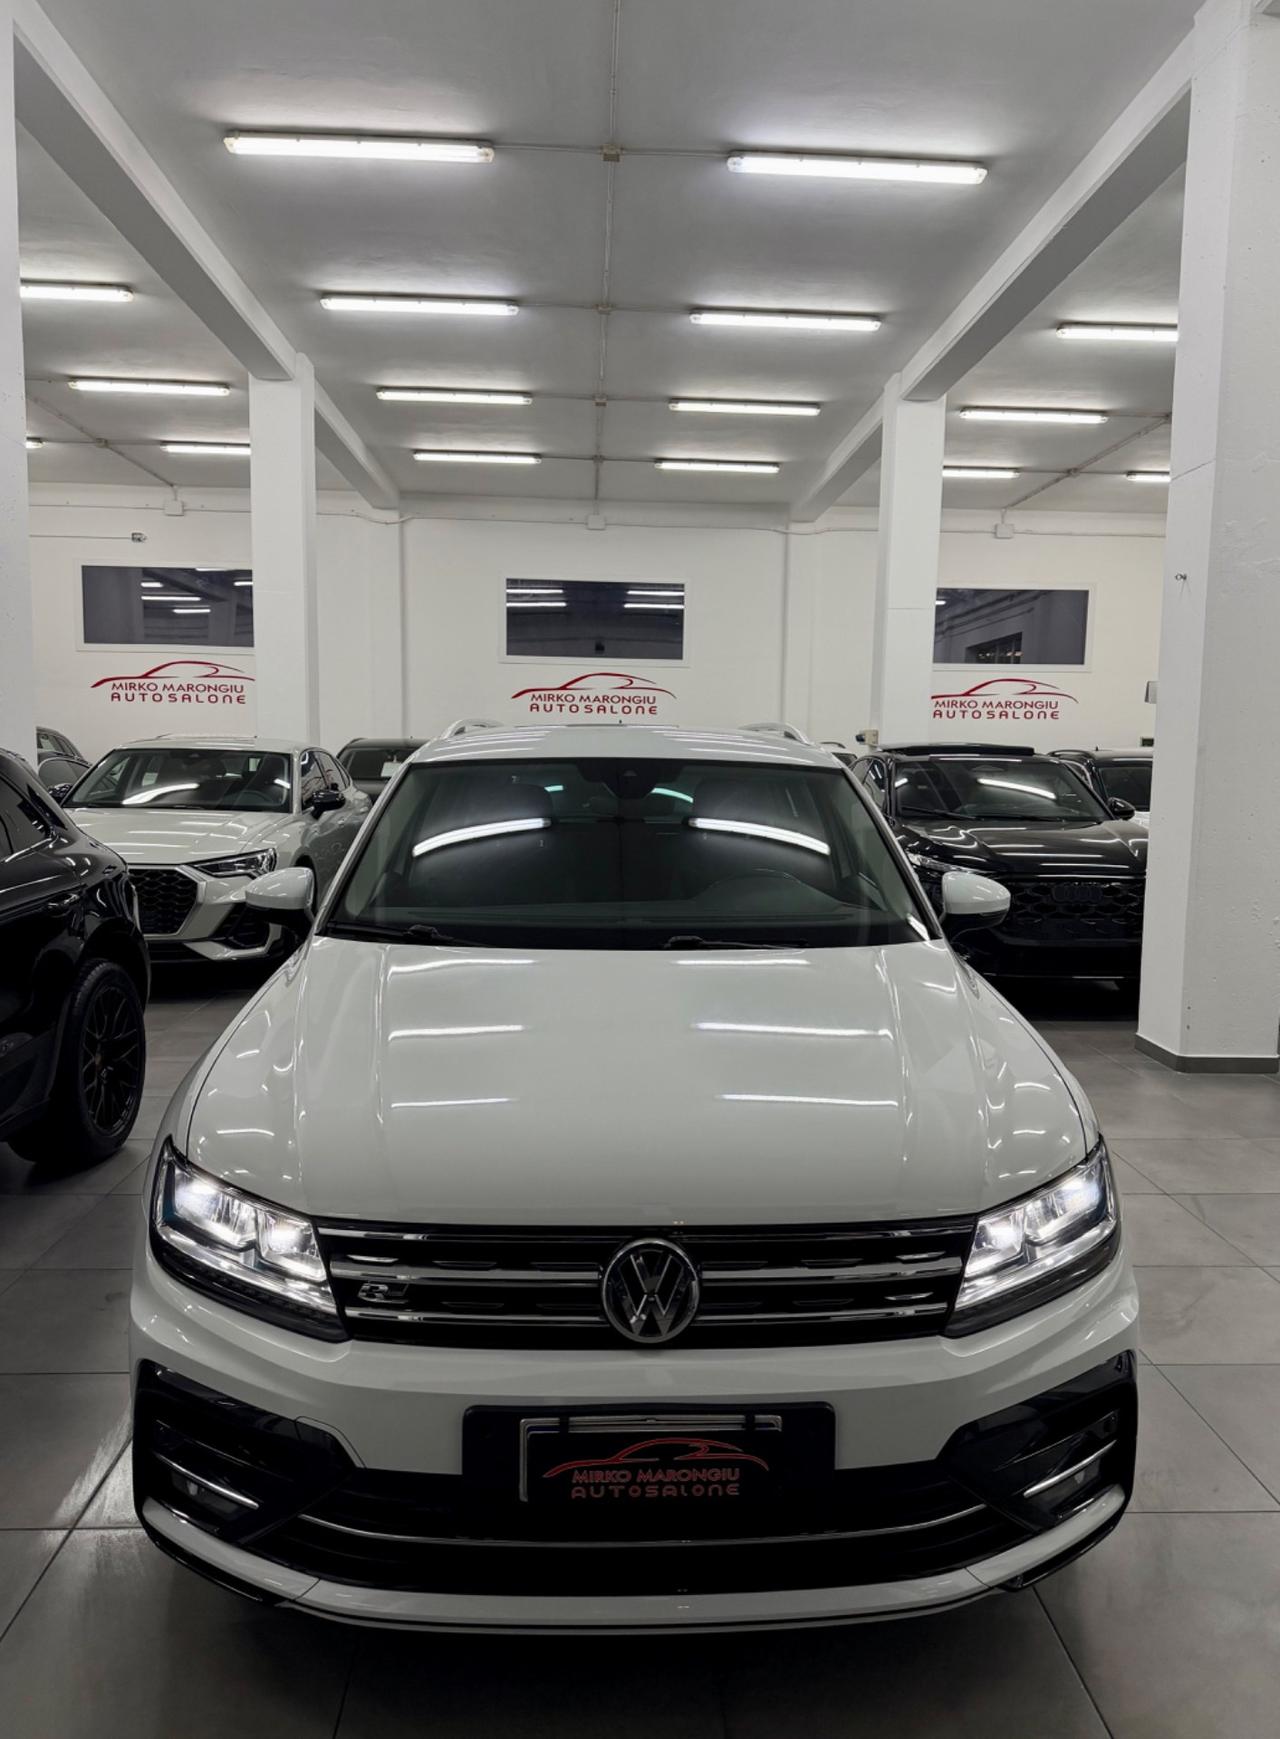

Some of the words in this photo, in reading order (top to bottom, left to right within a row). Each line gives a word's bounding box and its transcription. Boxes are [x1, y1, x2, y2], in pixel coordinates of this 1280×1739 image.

[111, 682, 158, 692] MIRKO
[162, 683, 244, 693] MARONGIU
[110, 692, 246, 704] AUTOSALONE
[530, 693, 575, 703] MIRKO
[579, 694, 656, 704] MARONGIU
[529, 703, 658, 715] AUTOSALONE
[934, 699, 978, 709] MIRKO
[981, 700, 1059, 710] MARONGIU
[932, 709, 1060, 720] AUTOSALONE
[572, 1469, 632, 1484] MIRKO
[636, 1468, 740, 1483] MARONGIU
[571, 1484, 740, 1498] AUTOSALONE
